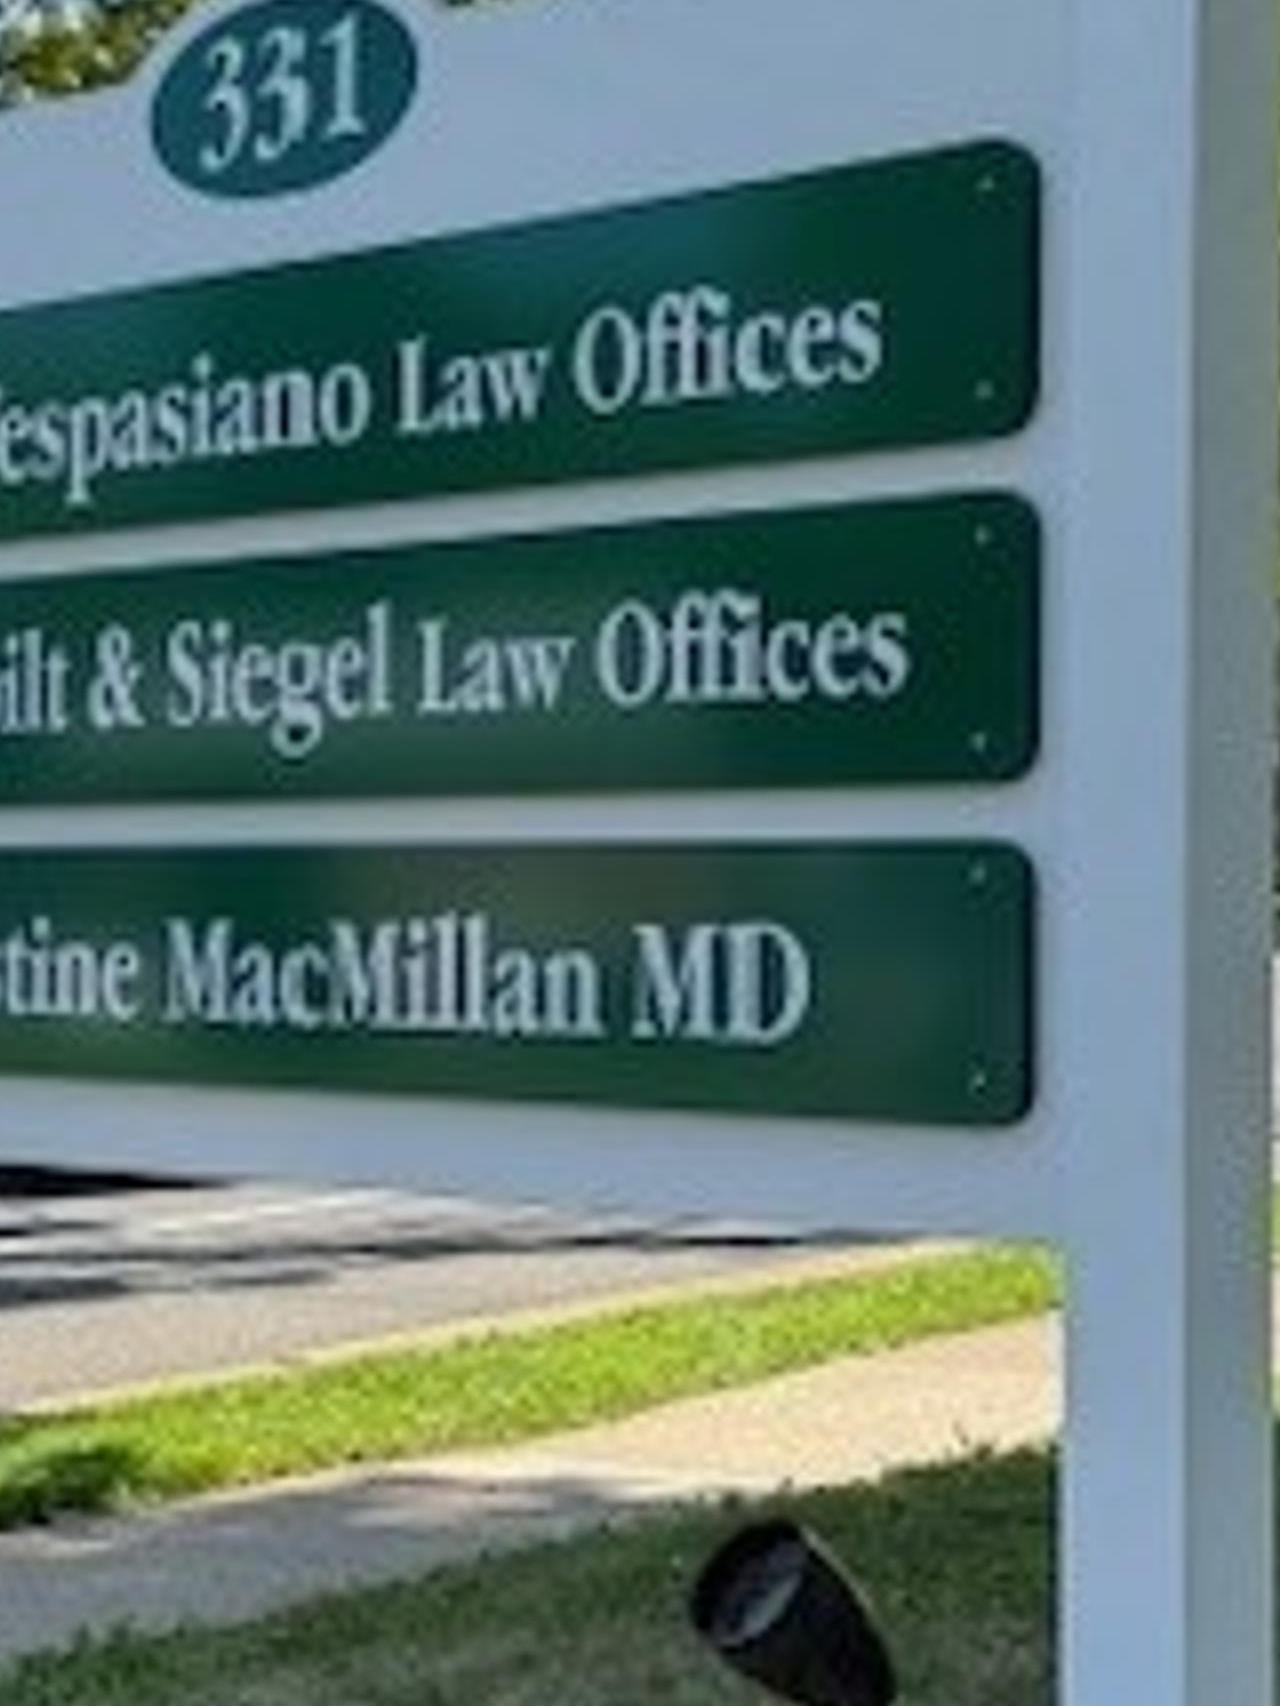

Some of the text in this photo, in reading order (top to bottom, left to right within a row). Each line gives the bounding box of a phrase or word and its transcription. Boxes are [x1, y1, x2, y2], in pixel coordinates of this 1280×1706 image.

[200, 14, 366, 173] 331
[398, 337, 552, 434] Law
[573, 286, 884, 414] Offices
[87, 624, 148, 731] &
[165, 603, 394, 758] Siegel
[416, 618, 578, 717] Law
[595, 589, 910, 708] Offices
[163, 909, 604, 1038] MacMillan
[630, 922, 812, 1046] MD
